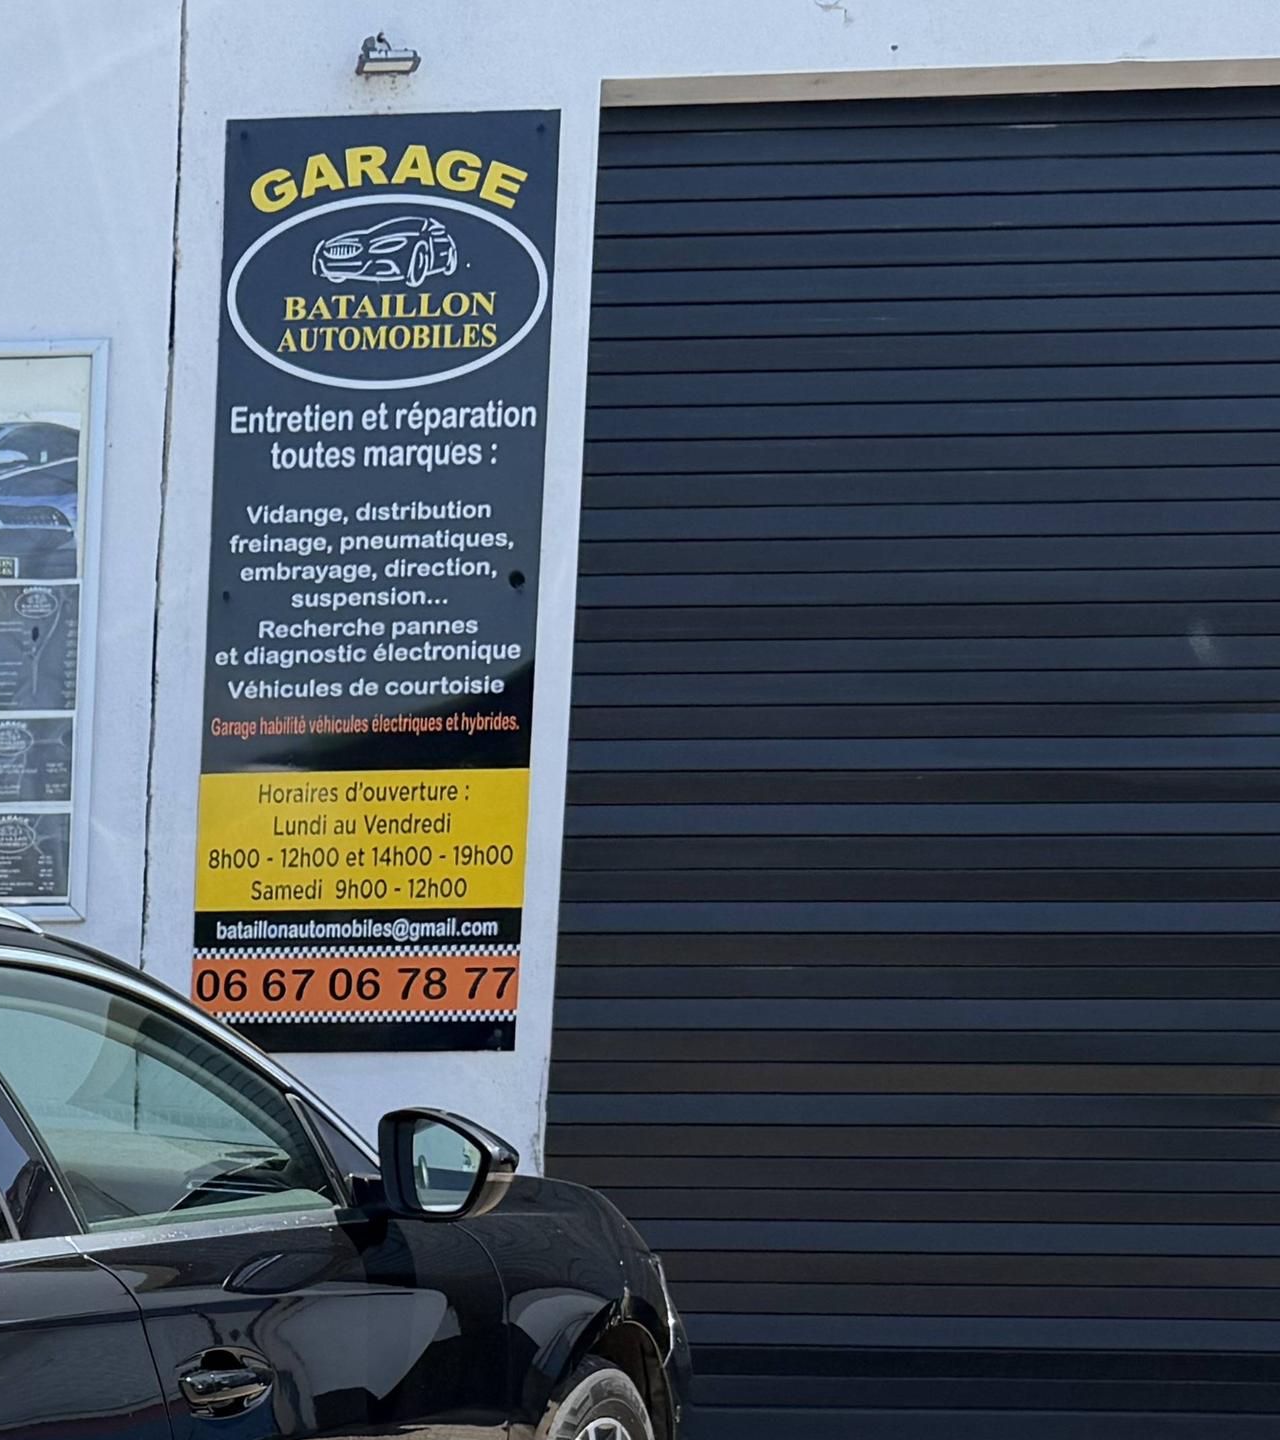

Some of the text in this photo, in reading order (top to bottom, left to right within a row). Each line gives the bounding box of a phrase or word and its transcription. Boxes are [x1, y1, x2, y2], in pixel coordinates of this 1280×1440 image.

[250, 144, 528, 213] GARAGE
[284, 291, 496, 321] BATAILLON
[277, 323, 497, 352] AUTOMOBILES
[231, 400, 537, 436] Entretien et réparation
[271, 442, 355, 470] toutes
[364, 442, 482, 472] marques
[246, 500, 492, 527] Vidange, distribution
[229, 529, 515, 555] freinage, pneumatiques,
[240, 558, 498, 584] embrayage, direction,
[291, 588, 449, 611] suspension...
[258, 618, 479, 640] Recherche pannes
[215, 640, 522, 669] et diagnostic électronique
[228, 674, 505, 699] Véhicules de courtoisie
[211, 711, 520, 740] Garage habilité véhicules électriques et hybrides.
[258, 783, 338, 804] Horaires
[345, 781, 458, 802] d'ouverture
[273, 812, 452, 836] Lundi au Vendredi
[208, 848, 260, 869] 8h00
[281, 847, 340, 868] 12h00
[346, 848, 366, 867] et
[372, 845, 432, 867] 14h00
[453, 844, 514, 866] 19h00
[251, 879, 323, 901] Samedi
[335, 878, 388, 899] 9h00
[408, 877, 468, 899] 12h00
[216, 917, 499, 942] bataillonautomobiles@gmail.com
[196, 966, 517, 1002] 06 67 06 78 77
